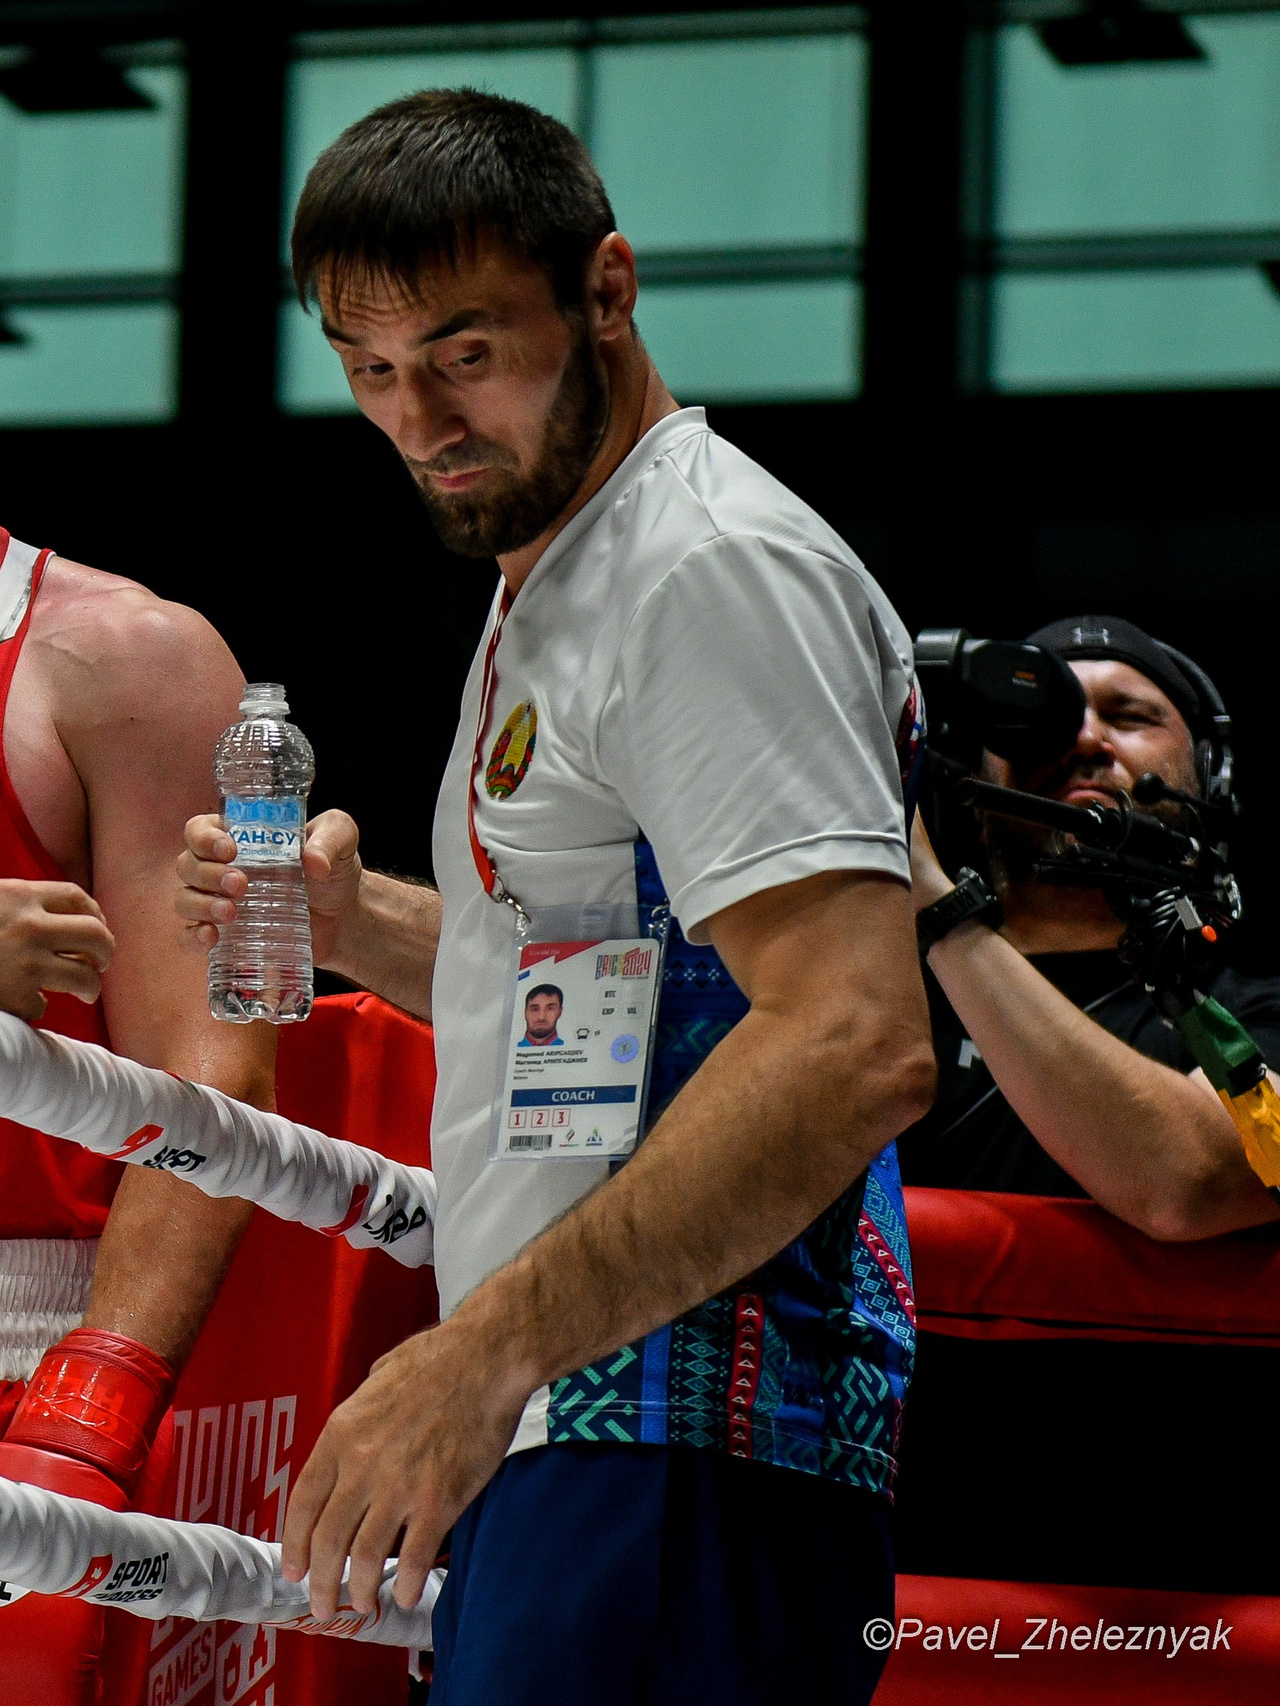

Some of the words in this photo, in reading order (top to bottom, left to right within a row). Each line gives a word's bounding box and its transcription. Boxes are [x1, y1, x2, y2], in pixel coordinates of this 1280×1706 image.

[551, 1090, 596, 1103] COACH
[514, 1113, 521, 1127] 1
[536, 1112, 544, 1126] 2
[557, 1111, 565, 1125] 3
[104, 1551, 170, 1591] SPORT
